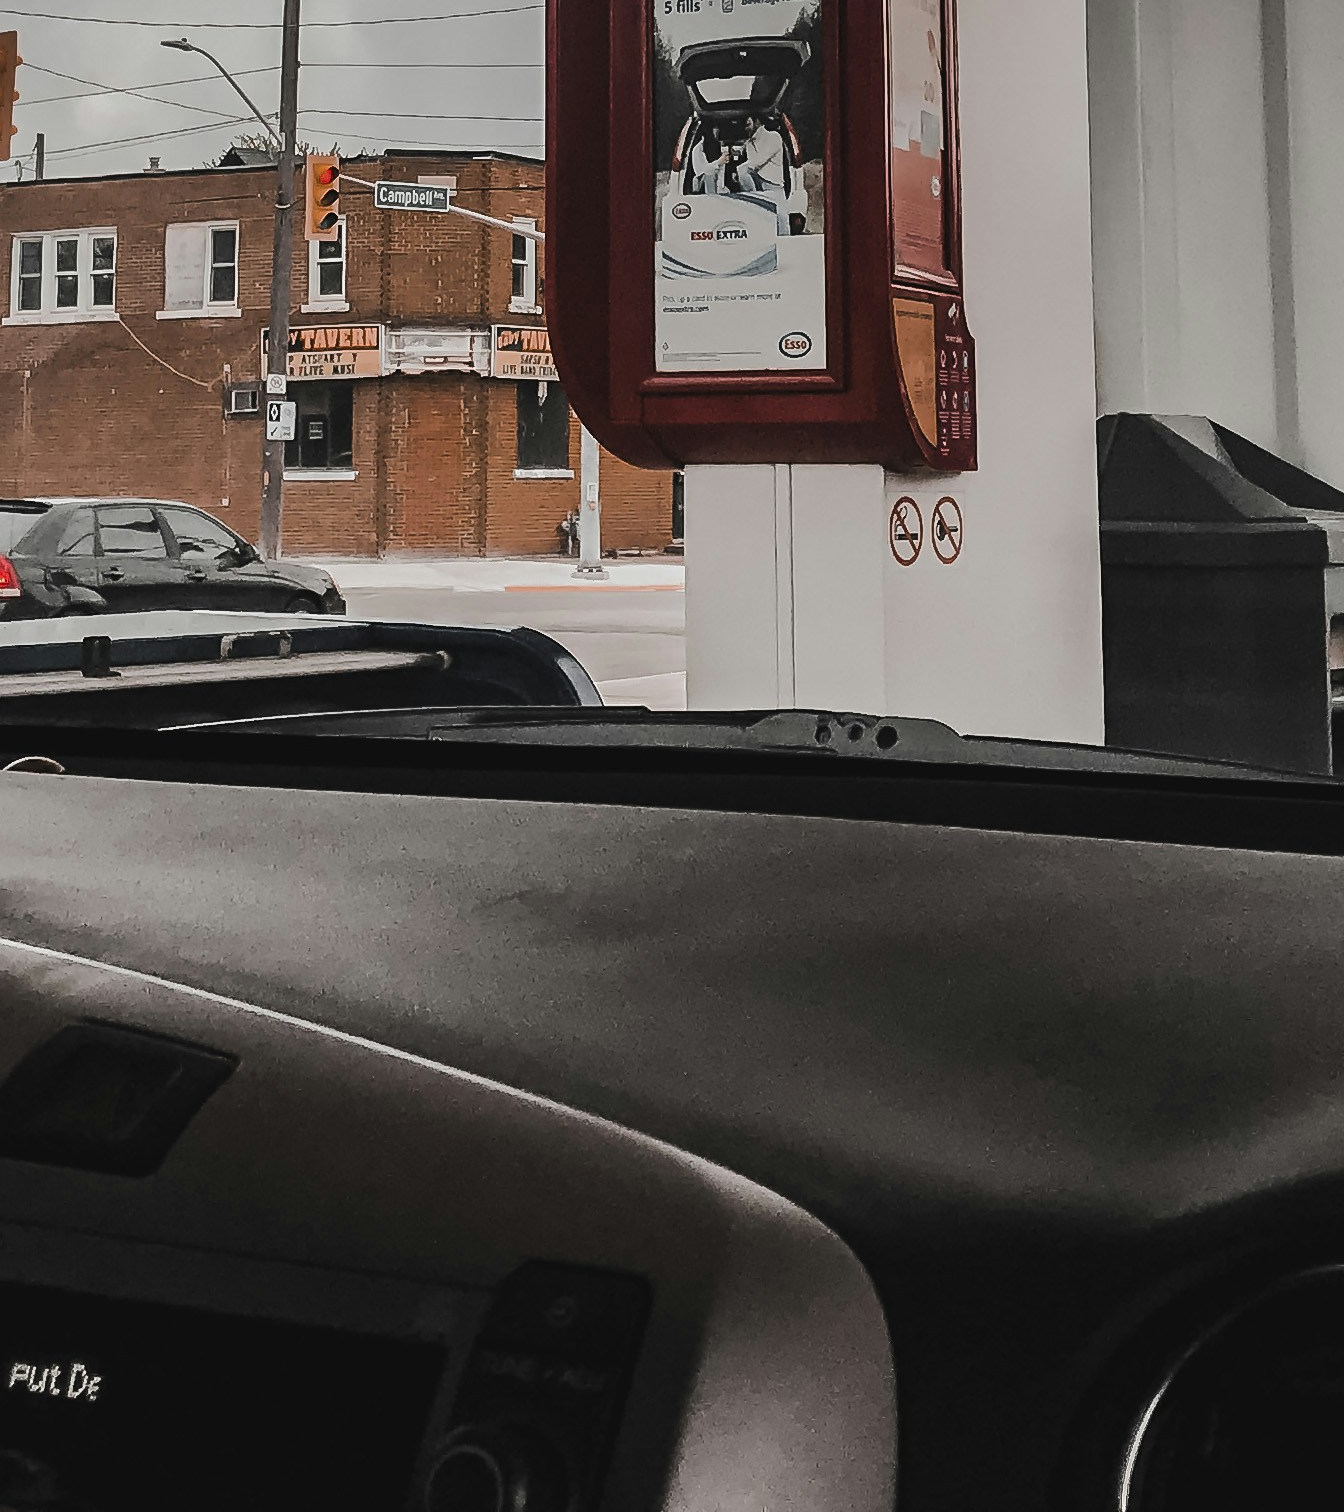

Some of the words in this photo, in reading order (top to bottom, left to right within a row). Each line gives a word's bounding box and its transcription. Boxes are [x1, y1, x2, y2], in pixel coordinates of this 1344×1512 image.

[664, 1, 672, 14] 5
[379, 186, 433, 207] Campbell
[691, 231, 713, 240] ESSO
[716, 230, 748, 240] EXTRA
[300, 327, 378, 350] TAVERN
